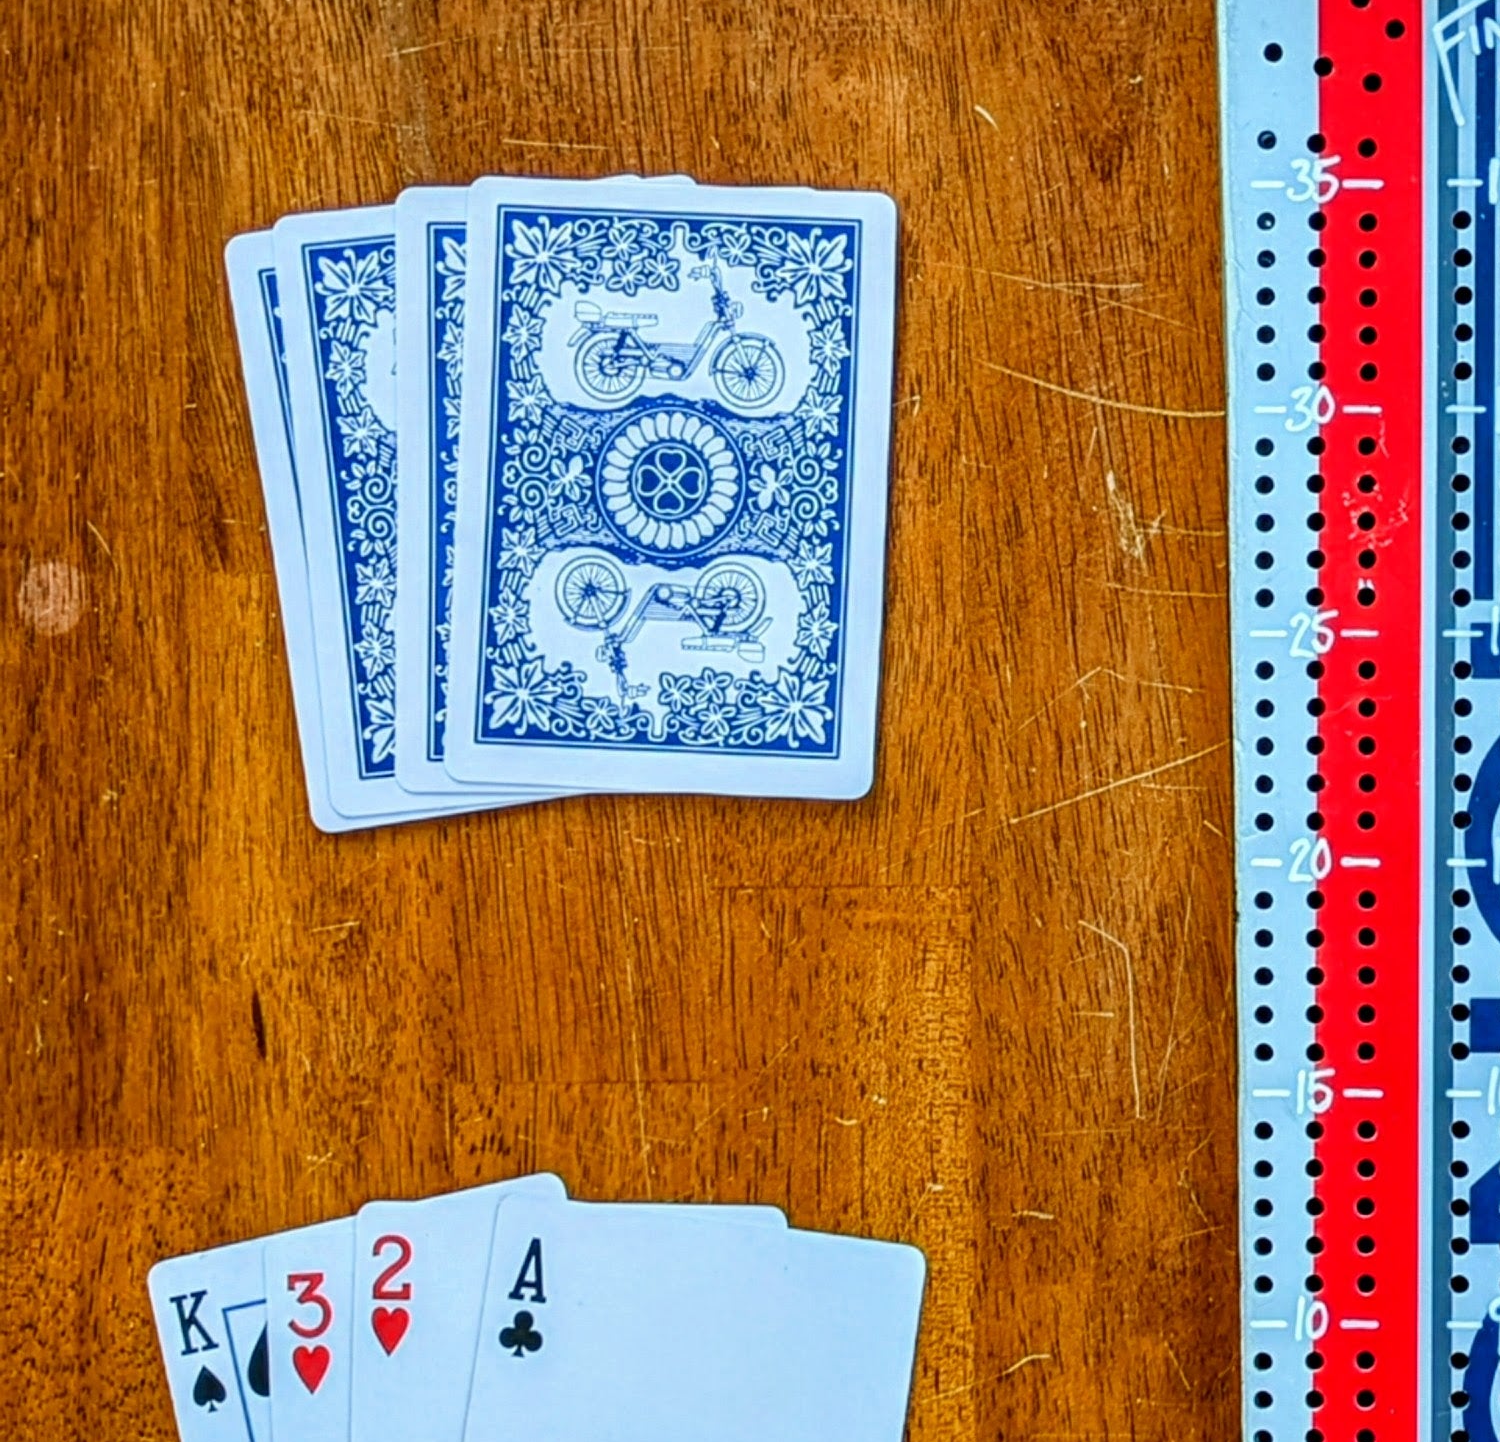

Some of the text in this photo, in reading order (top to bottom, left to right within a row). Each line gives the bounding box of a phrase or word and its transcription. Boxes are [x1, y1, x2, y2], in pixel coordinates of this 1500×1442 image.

[1287, 156, 1341, 203] 35
[1284, 388, 1335, 432] 30
[1289, 611, 1339, 656] 25
[1288, 839, 1333, 882] 20
[1294, 1069, 1335, 1113] 15
[371, 1234, 412, 1300] 2
[508, 1237, 547, 1303] A
[170, 1291, 219, 1355] K
[286, 1272, 332, 1339] 3
[1295, 1299, 1329, 1342] 10
